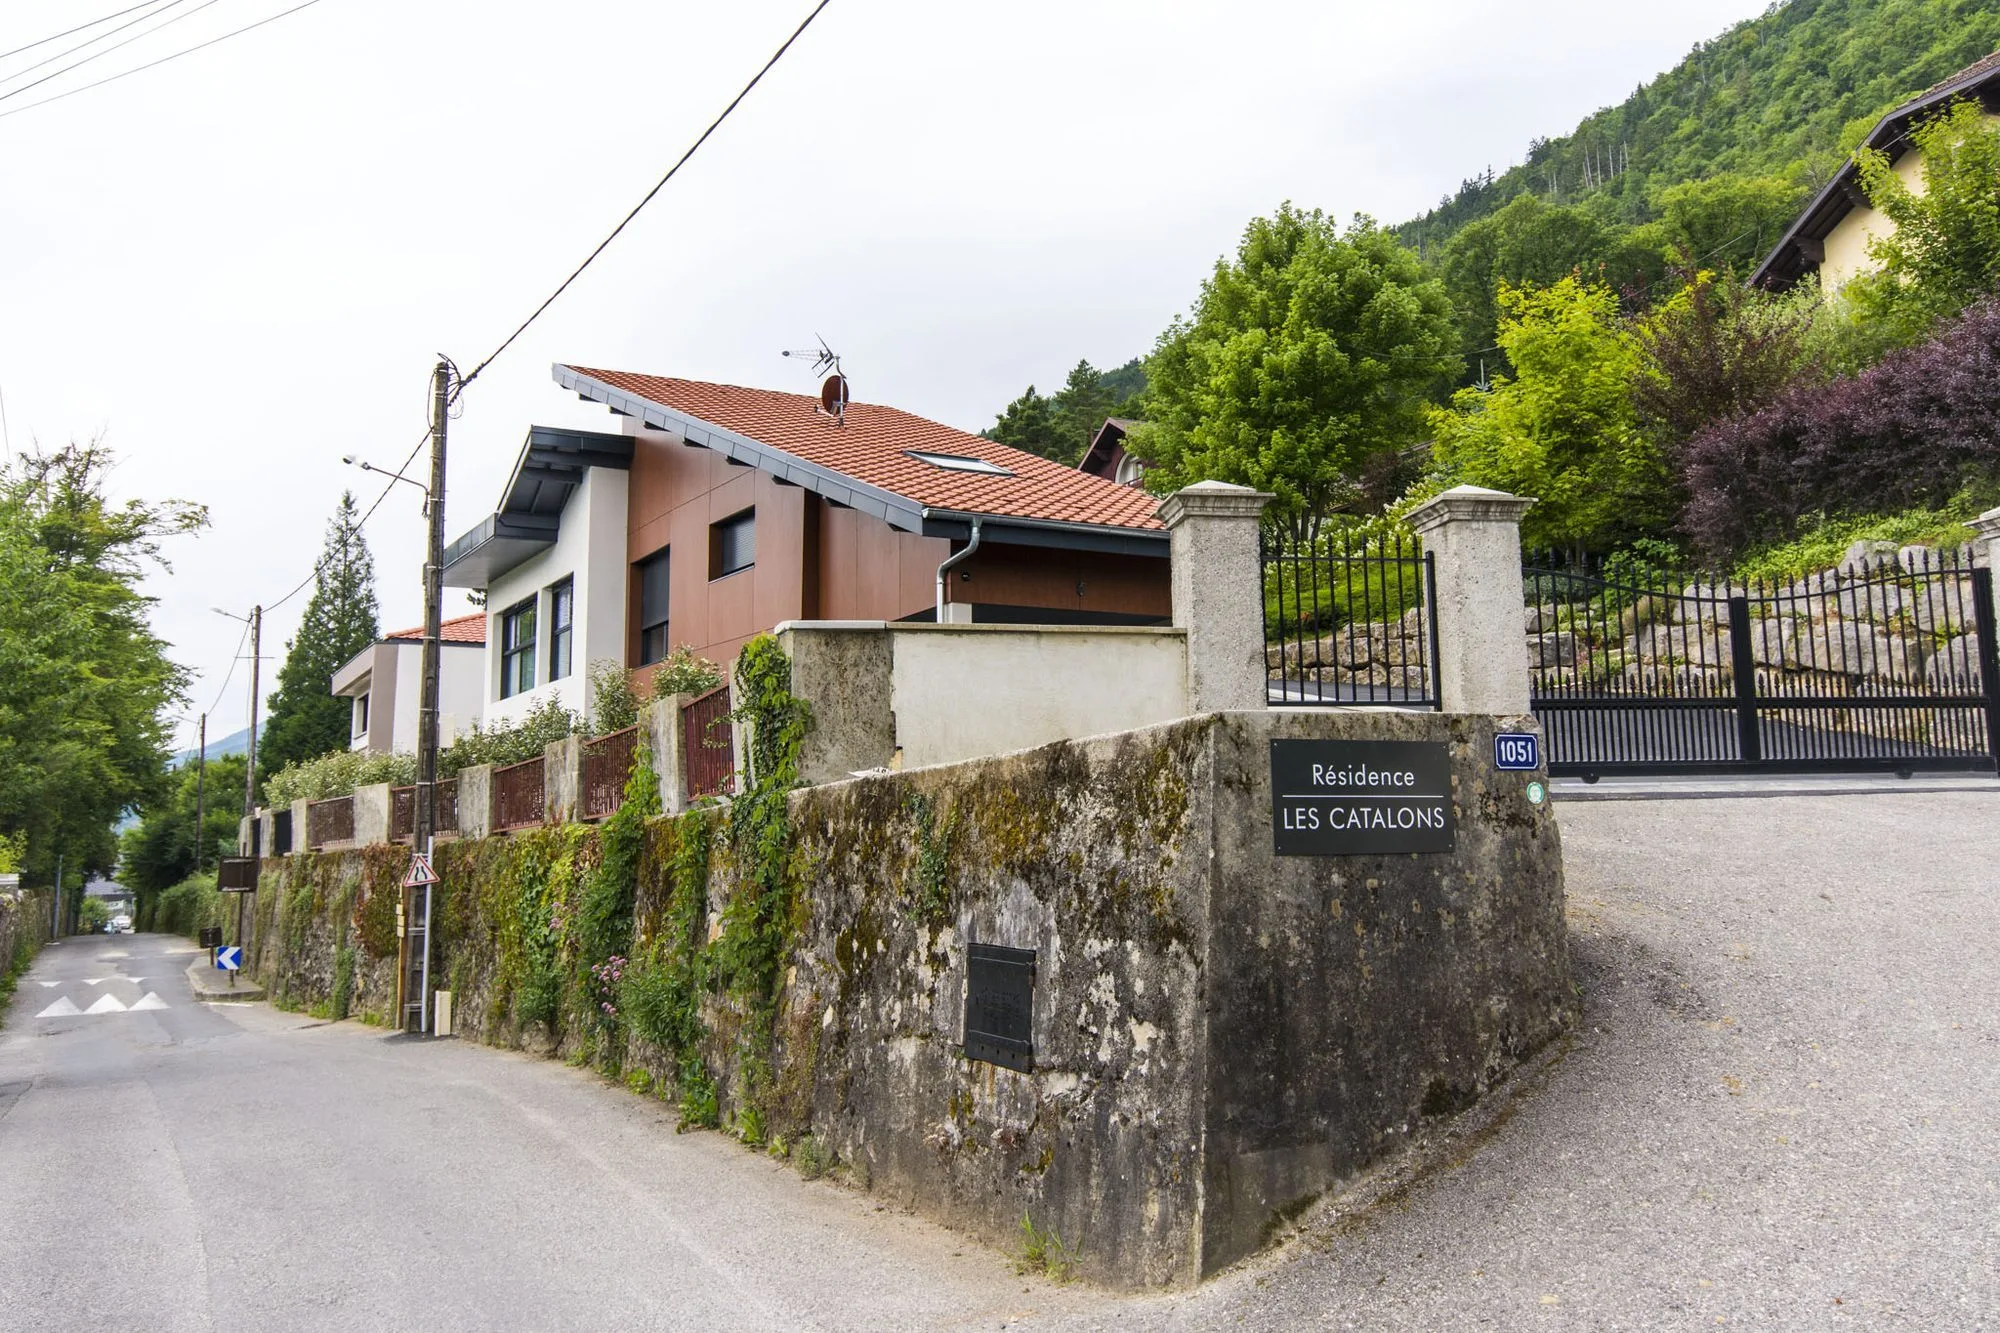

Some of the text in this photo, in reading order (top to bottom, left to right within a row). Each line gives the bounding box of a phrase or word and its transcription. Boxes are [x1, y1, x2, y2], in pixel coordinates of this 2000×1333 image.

[1500, 740, 1533, 763] 1051
[1312, 763, 1415, 787] Résidence
[1283, 806, 1445, 830] LES CATALONS
